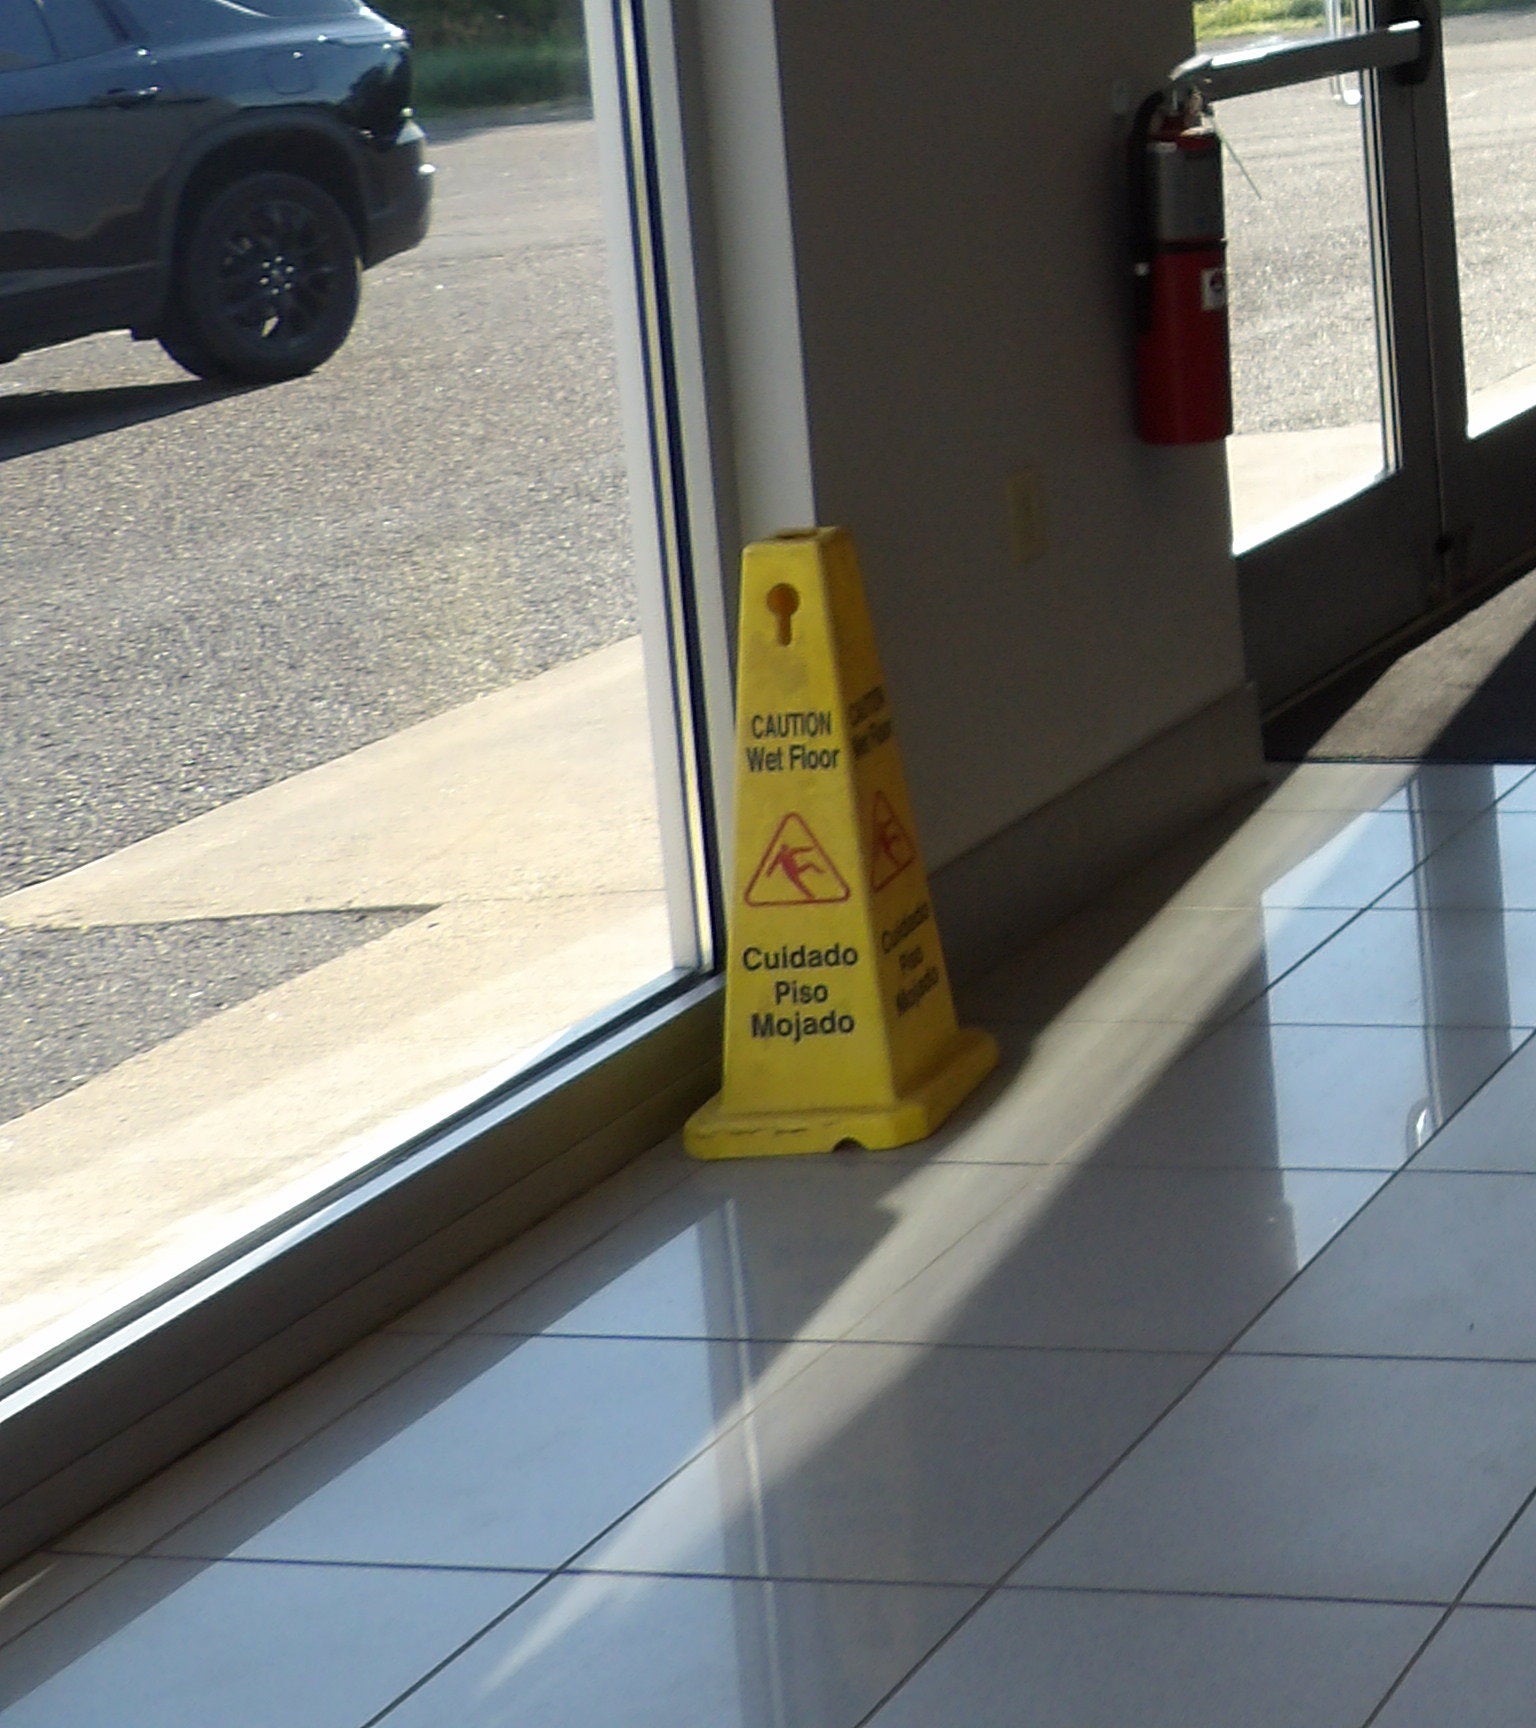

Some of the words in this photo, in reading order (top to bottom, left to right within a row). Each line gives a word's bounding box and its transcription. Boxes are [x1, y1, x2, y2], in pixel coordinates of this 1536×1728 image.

[751, 711, 831, 739] CAUTION
[746, 747, 783, 772] Wet
[789, 744, 840, 770] Floor
[742, 943, 859, 971] Cuidado
[775, 980, 828, 1005] Piso
[751, 1010, 855, 1044] Mojado
